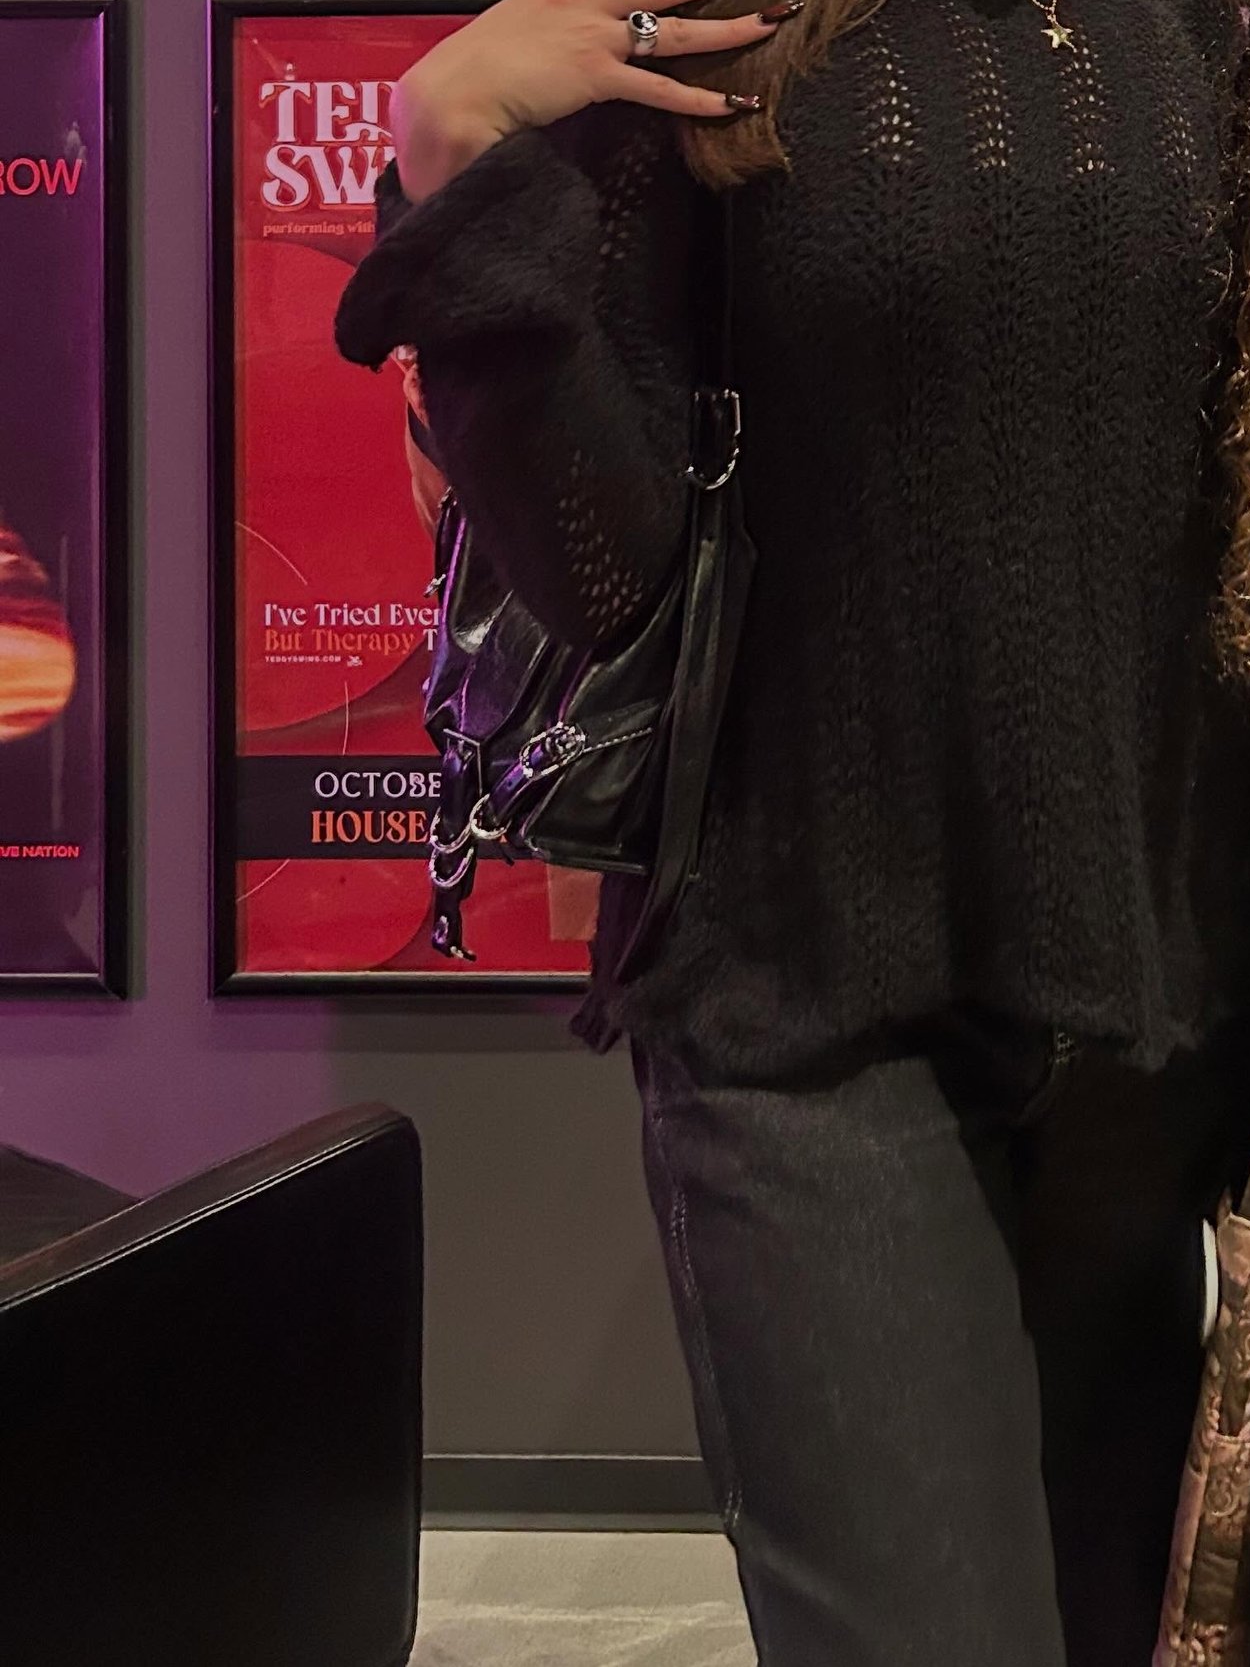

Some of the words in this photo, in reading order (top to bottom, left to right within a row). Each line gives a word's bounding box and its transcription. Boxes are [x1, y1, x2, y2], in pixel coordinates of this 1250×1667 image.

[264, 602, 307, 627] I've
[314, 602, 382, 627] Tried
[264, 628, 304, 652] But
[311, 628, 416, 656] Therapy
[310, 809, 430, 844] HOUSE
[23, 845, 79, 858] NATION
